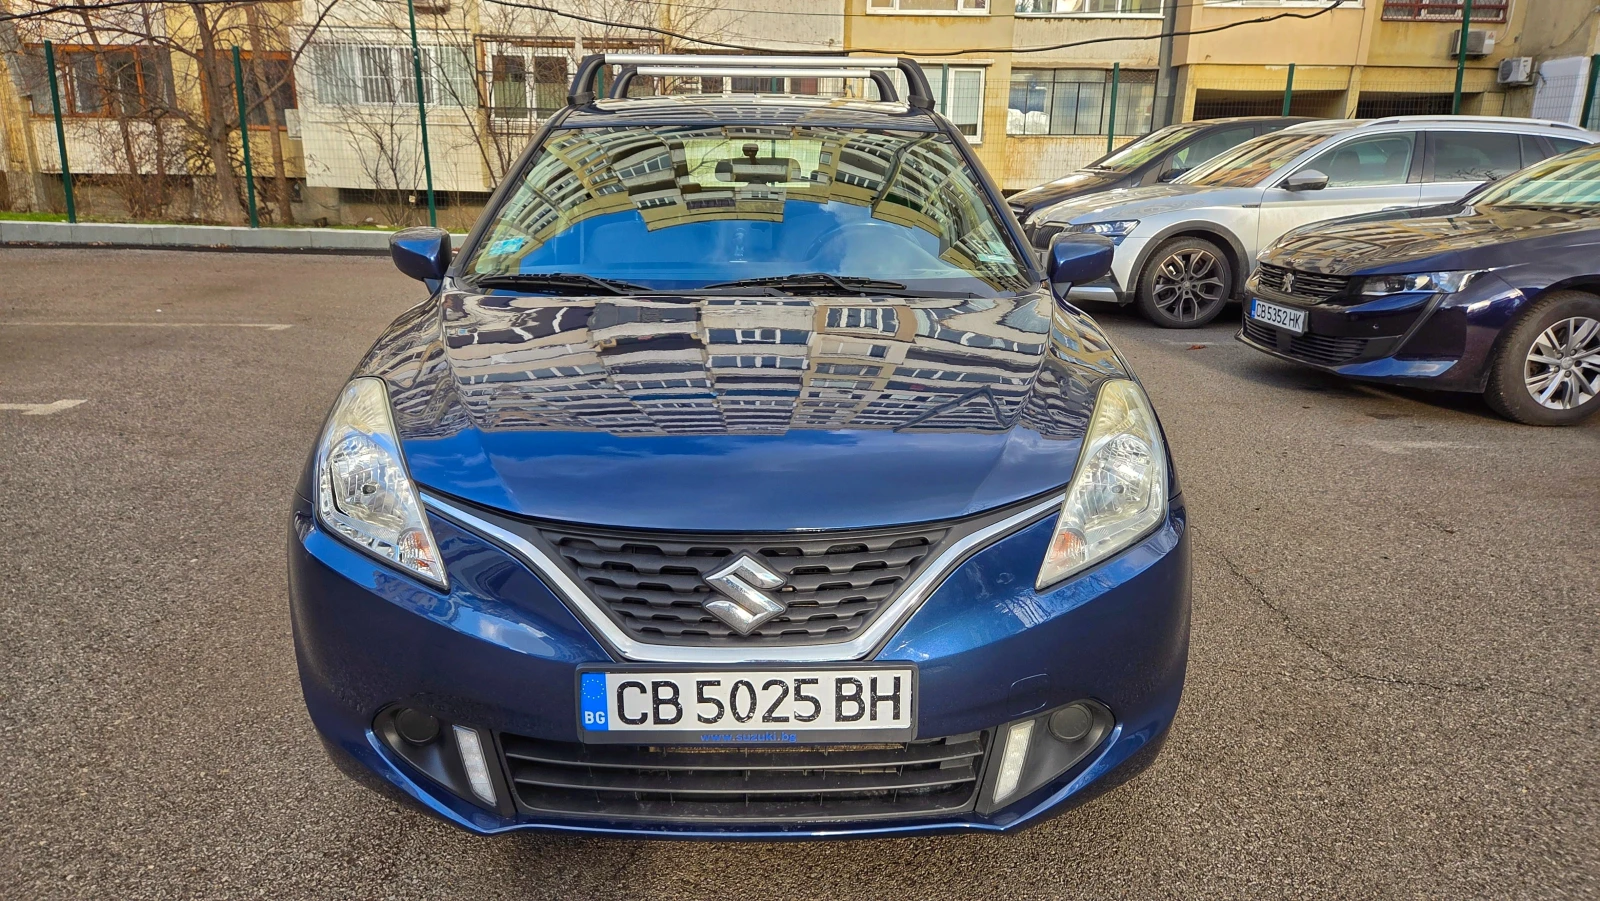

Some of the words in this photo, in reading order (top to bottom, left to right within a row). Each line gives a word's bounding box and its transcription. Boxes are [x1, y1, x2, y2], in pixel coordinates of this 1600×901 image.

[1256, 303, 1266, 319] CB
[1267, 307, 1288, 326] 5352
[1289, 312, 1301, 330] HK
[616, 680, 683, 725] CB
[696, 678, 822, 724] 5025
[834, 676, 901, 723] BH
[584, 711, 606, 725] BG
[700, 732, 797, 743] www.suzuki.bg
